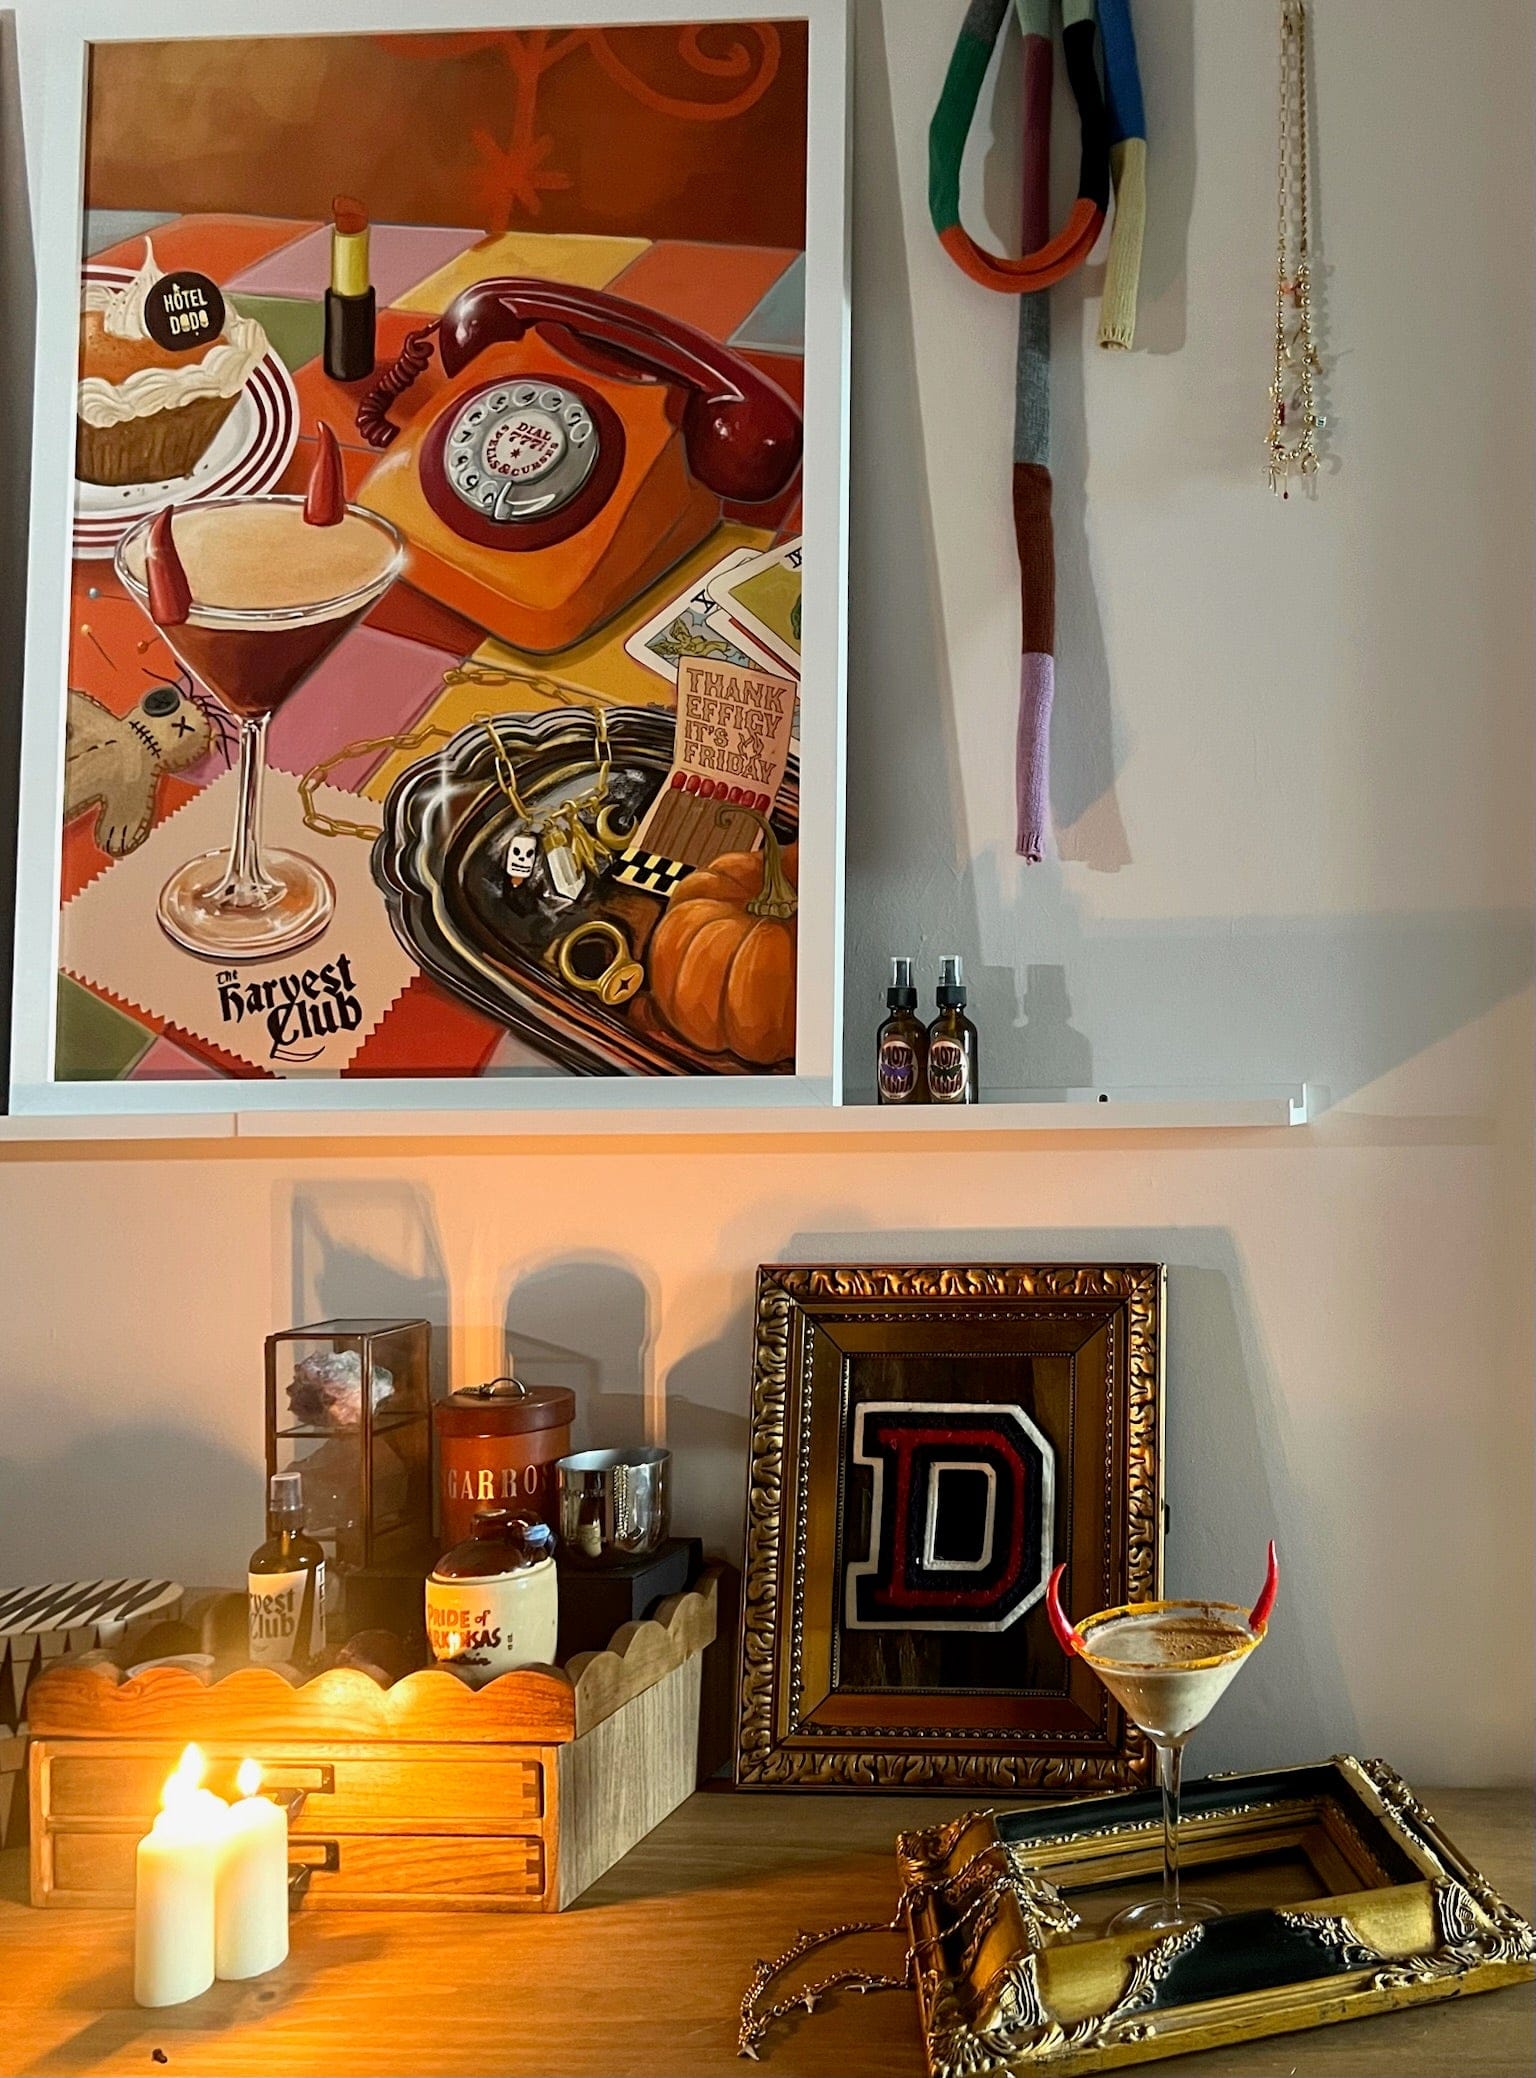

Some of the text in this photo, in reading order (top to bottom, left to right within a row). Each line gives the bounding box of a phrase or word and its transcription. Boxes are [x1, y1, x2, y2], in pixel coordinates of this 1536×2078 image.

[169, 309, 209, 335] DODO
[516, 422, 552, 441] DIAL
[497, 463, 511, 475] &
[510, 442, 559, 477] CURSES
[686, 668, 786, 714] THANK
[686, 693, 783, 739] EFFIGY
[684, 719, 729, 750] IT'S
[683, 740, 776, 785] FRIDAY
[267, 991, 362, 1059] Club
[846, 1401, 1055, 1632] D
[428, 1603, 491, 1628] PRIDE of
[430, 1627, 501, 1650] RKNSAS
